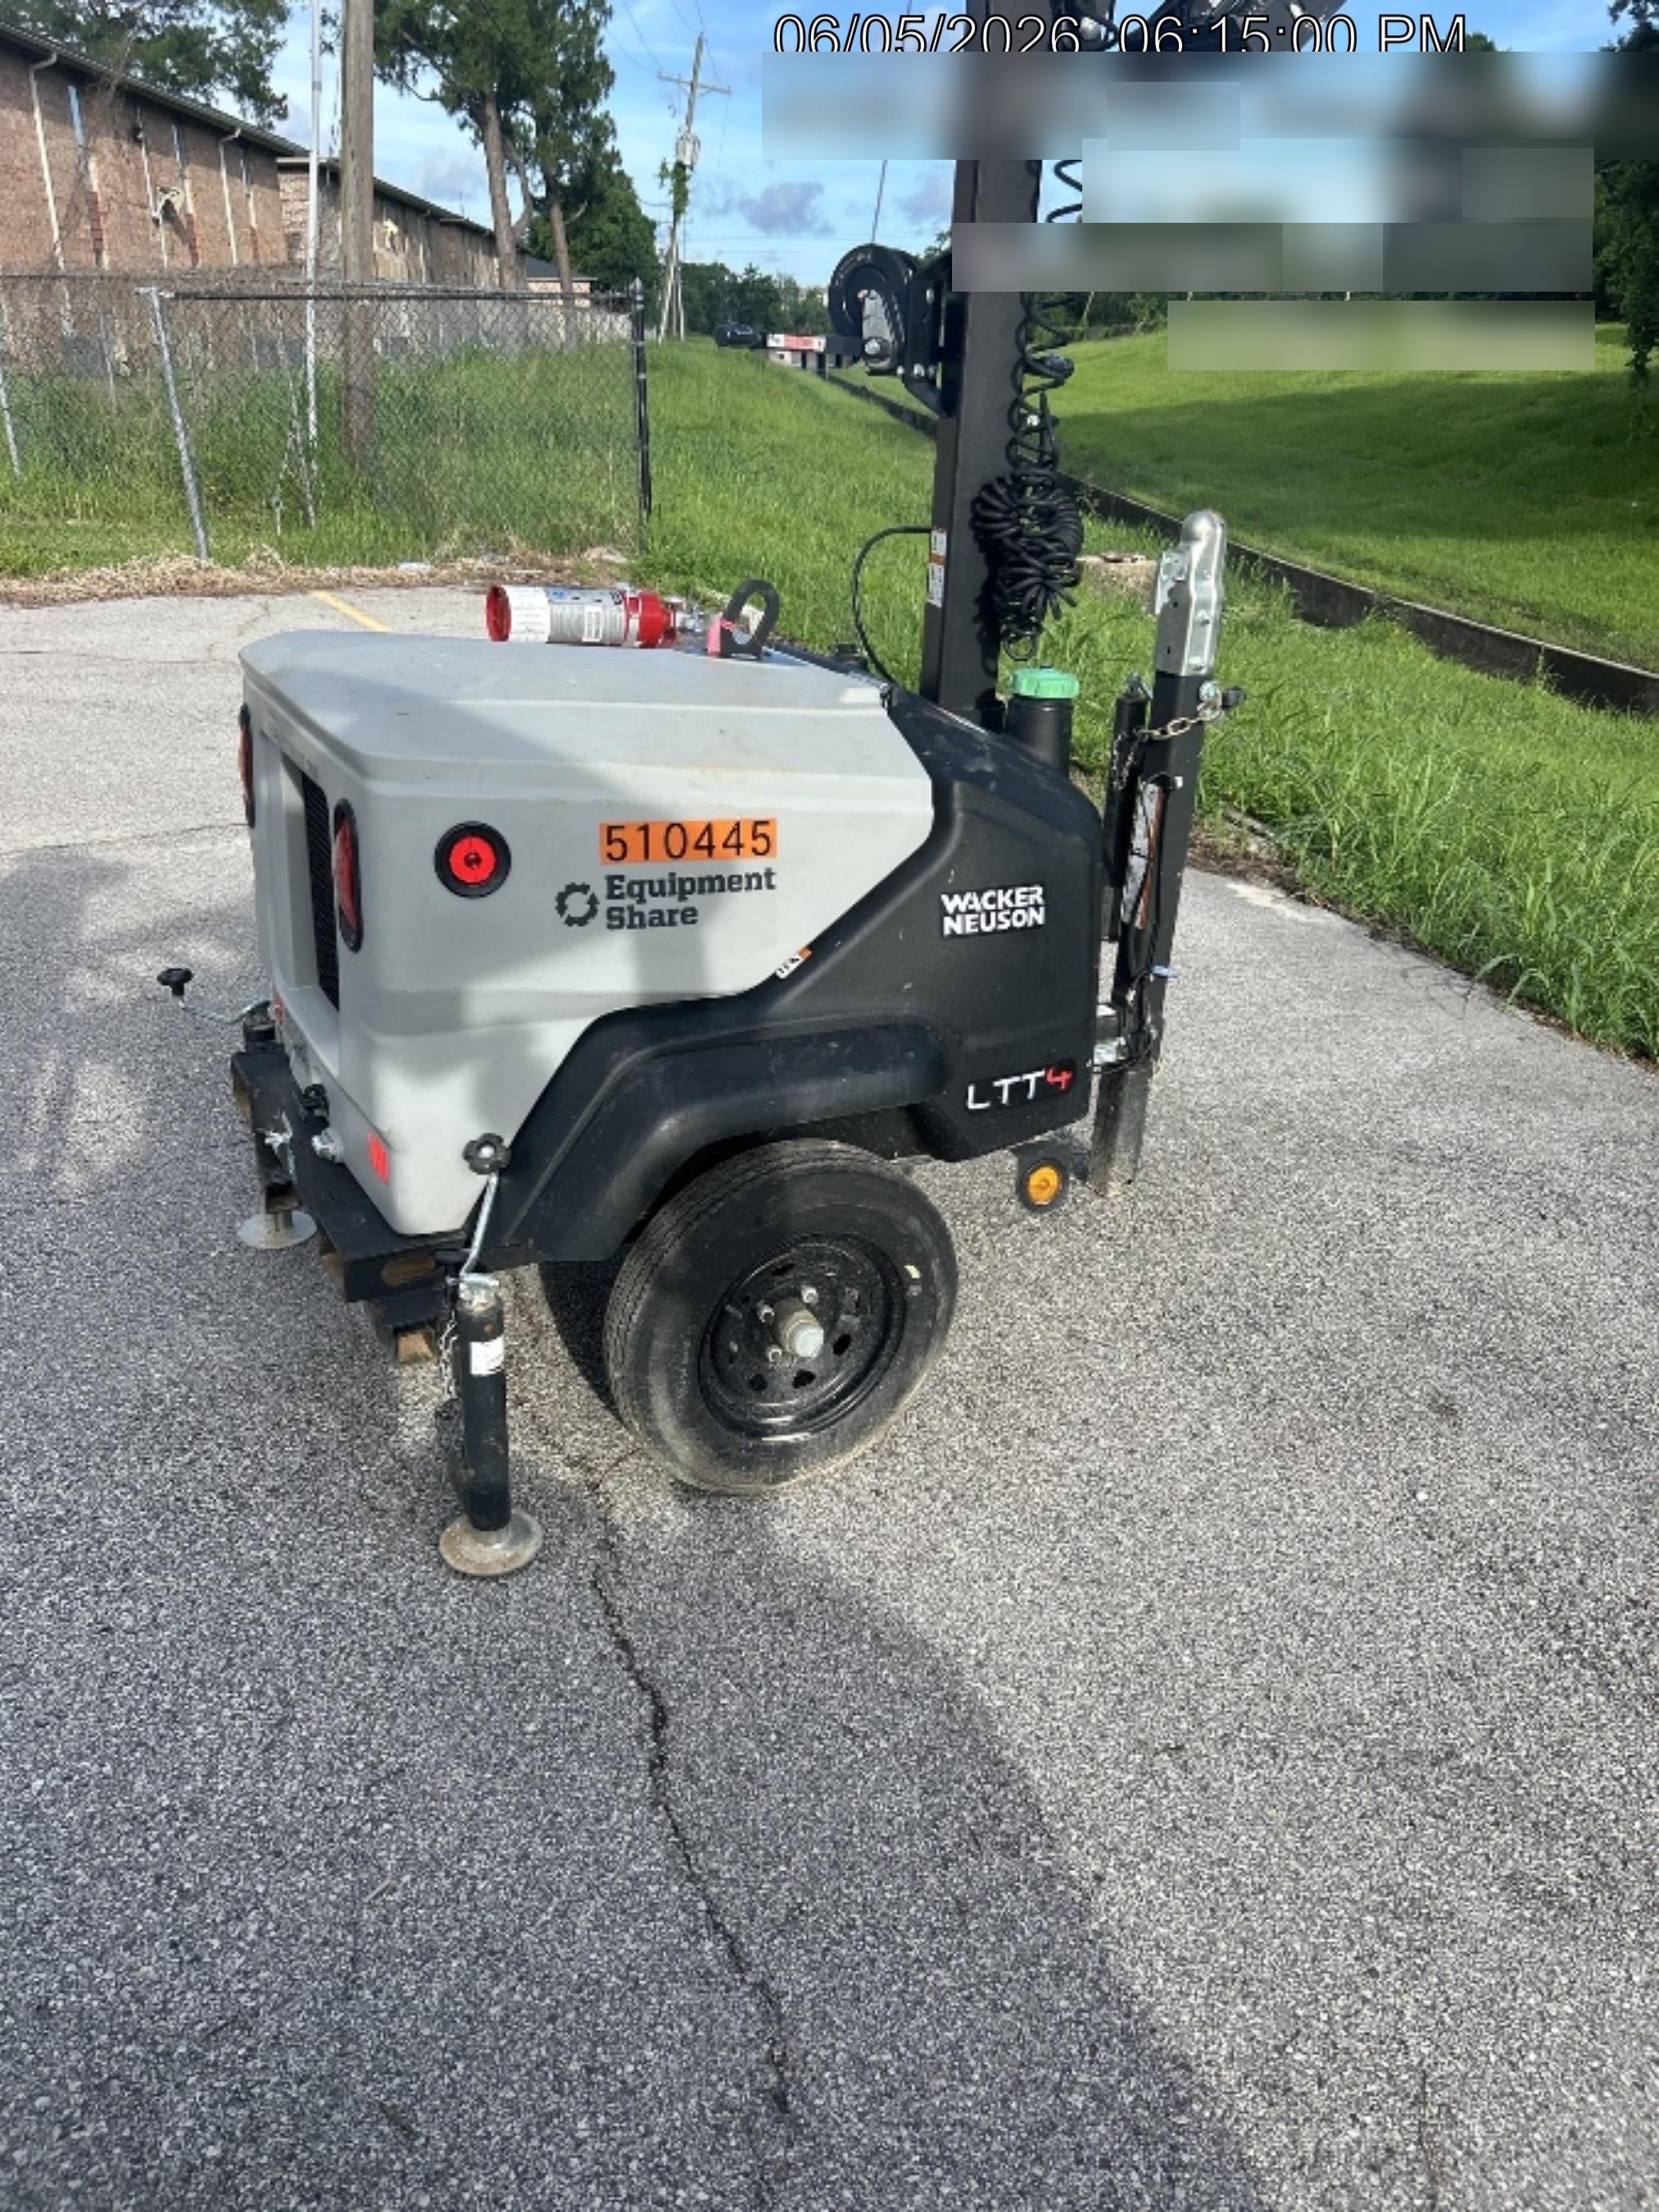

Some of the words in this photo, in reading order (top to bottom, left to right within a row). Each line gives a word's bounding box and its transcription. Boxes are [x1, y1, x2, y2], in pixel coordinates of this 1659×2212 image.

[605, 820, 772, 861] 510445
[605, 868, 777, 904] Equipment
[941, 885, 1045, 914] WACKER
[605, 905, 699, 931] Share
[943, 906, 1046, 936] NEUSON
